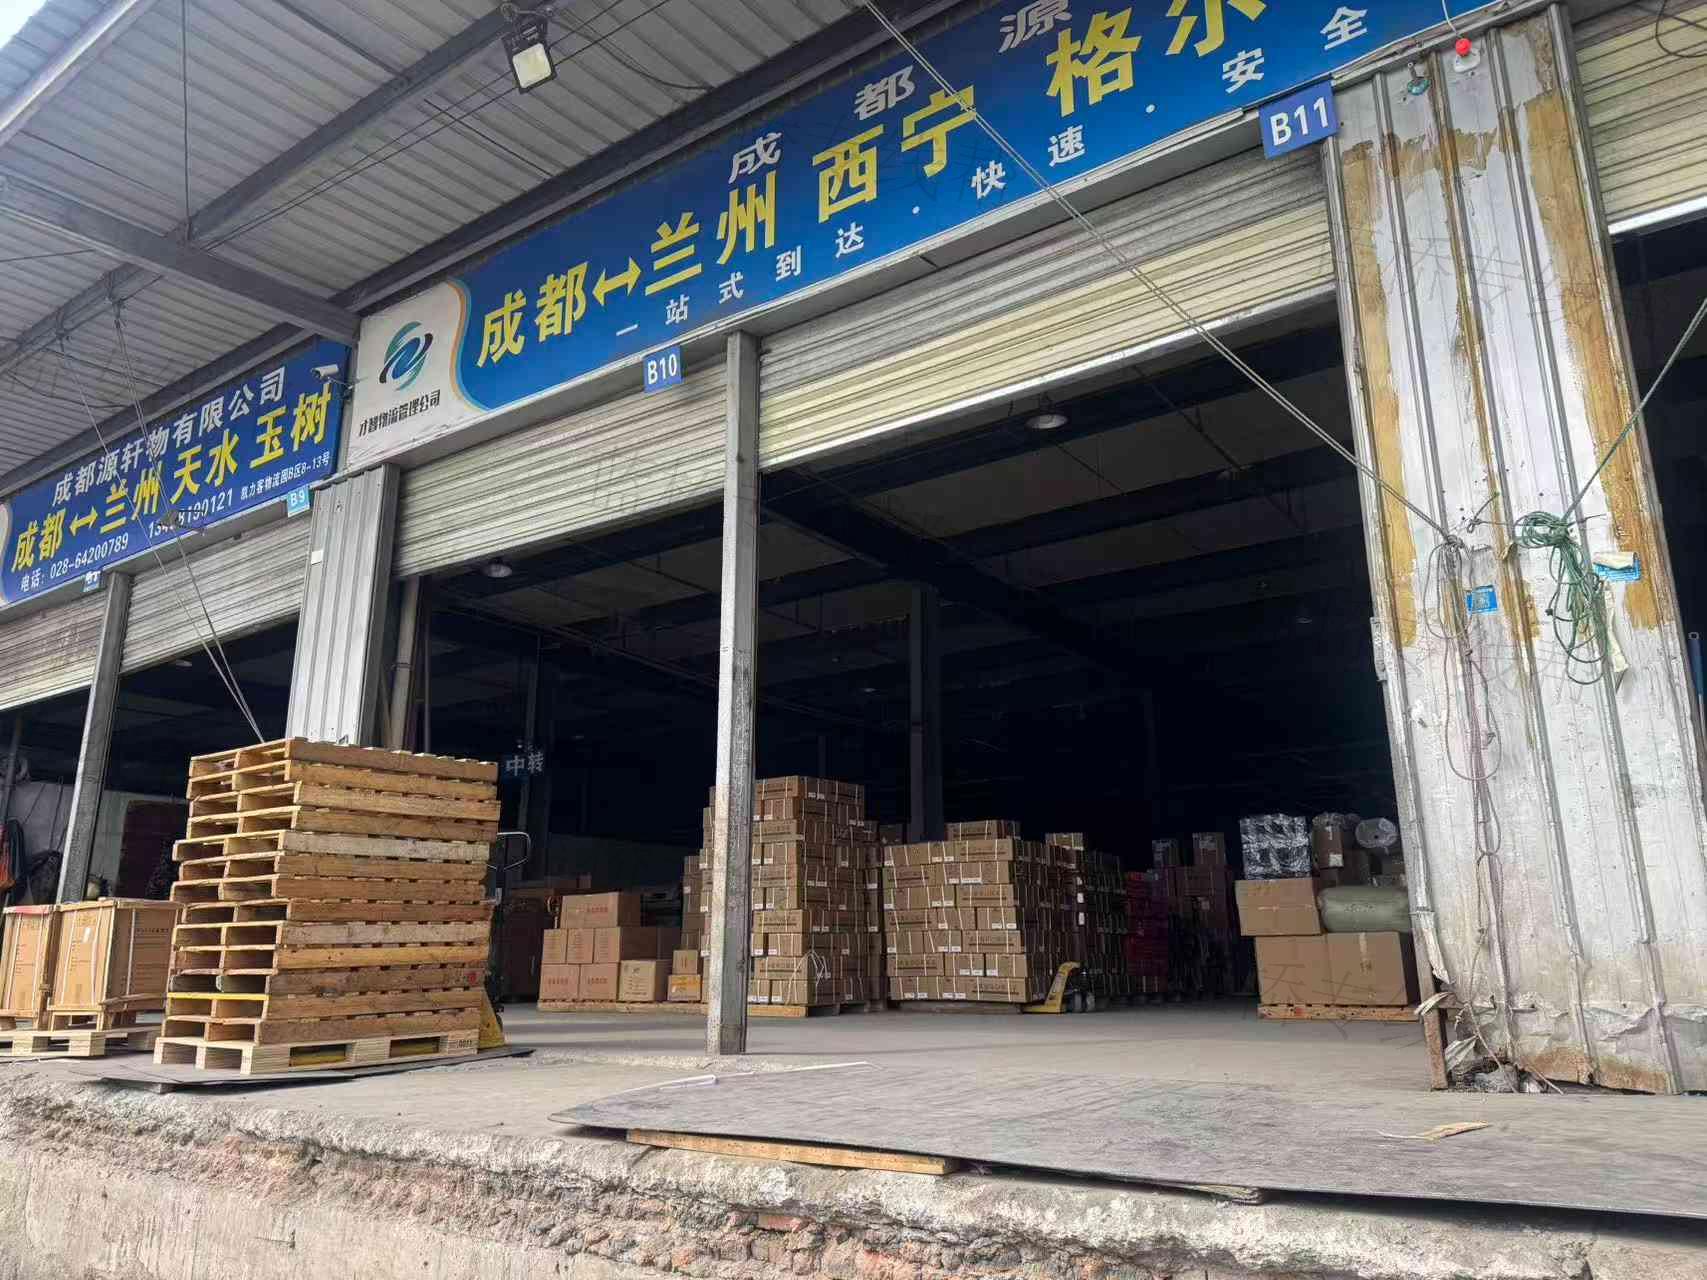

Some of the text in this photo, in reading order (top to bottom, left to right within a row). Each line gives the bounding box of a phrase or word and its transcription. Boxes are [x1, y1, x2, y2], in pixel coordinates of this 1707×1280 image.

[1269, 96, 1330, 147] B11
[477, 262, 588, 368] 成都
[645, 170, 776, 296] 兰州
[812, 85, 976, 224] 西宁
[647, 354, 678, 385] B10
[11, 382, 332, 573] 成都 兰州 天水 玉树
[290, 489, 306, 507] B9
[50, 532, 129, 579] 028-64200789
